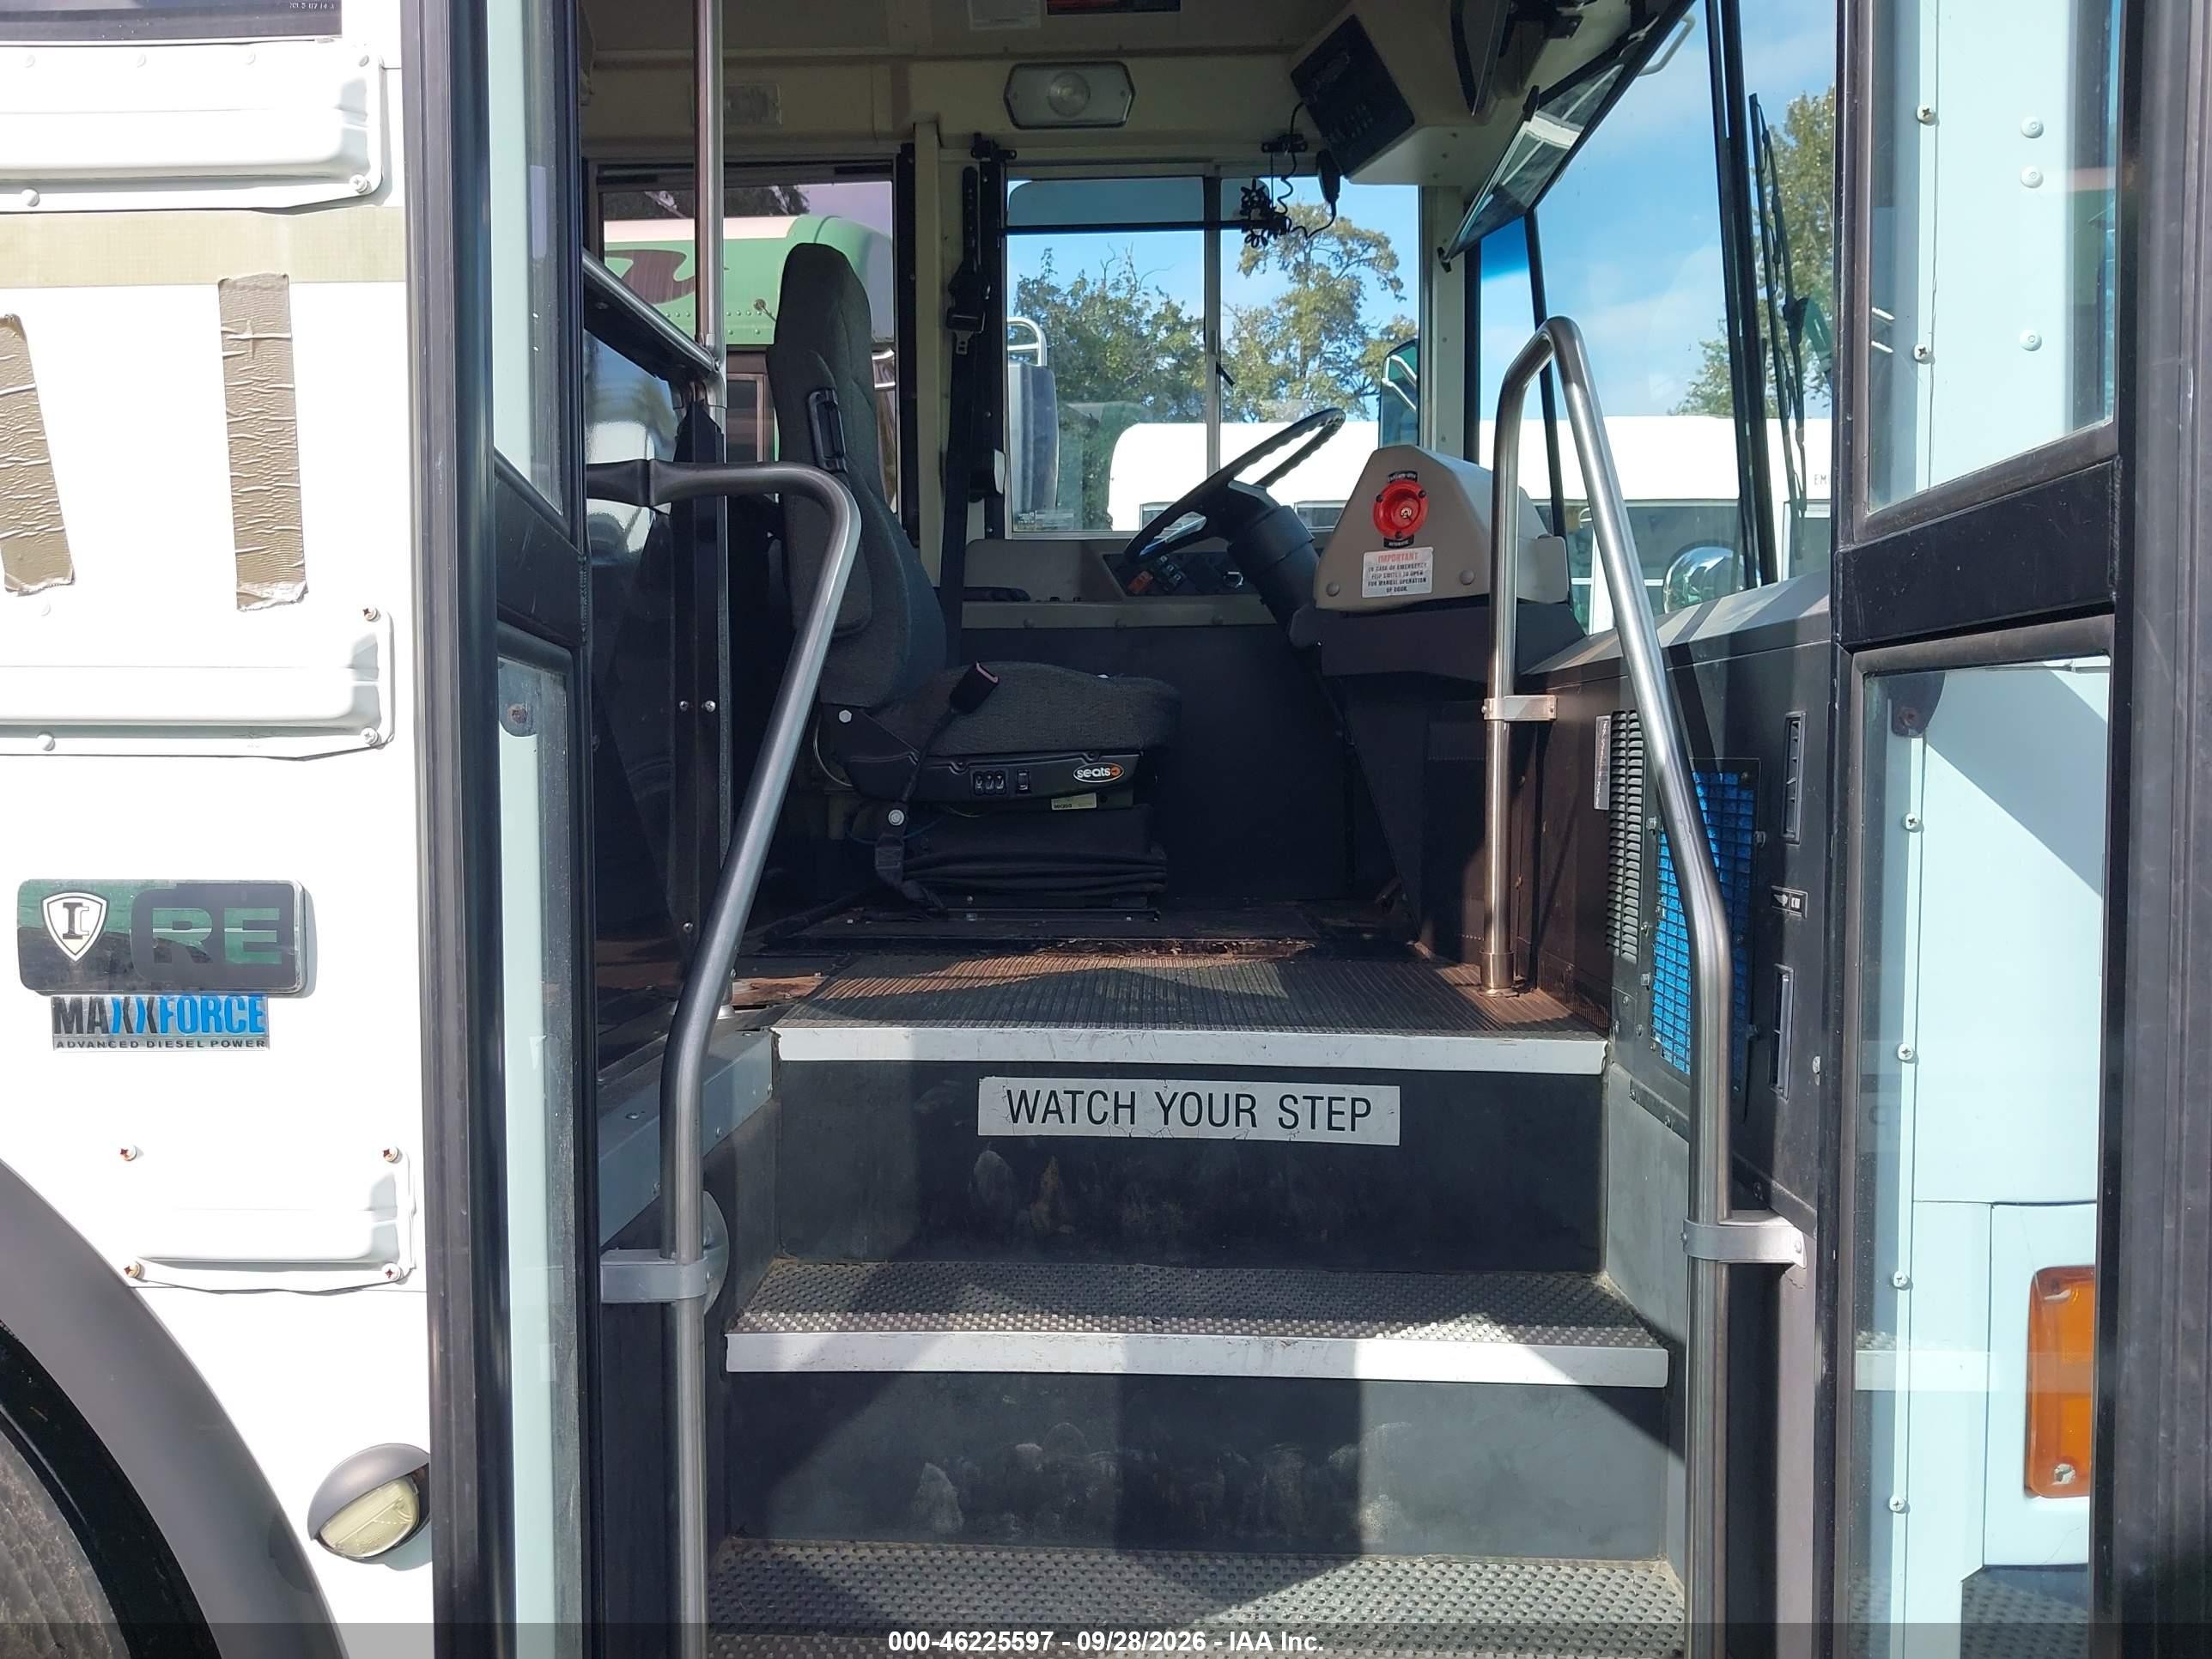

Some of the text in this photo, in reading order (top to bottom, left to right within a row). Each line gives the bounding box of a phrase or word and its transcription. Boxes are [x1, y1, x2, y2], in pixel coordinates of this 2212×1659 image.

[1378, 552, 1418, 563] IMPORTANT
[1077, 767, 1111, 779] seats
[152, 907, 283, 964] RE
[52, 994, 266, 1035] MAXXFORCE
[56, 1039, 266, 1049] ADVANCED DIESEL POWER
[1006, 1089, 1371, 1132] WATCH YOUR STEP
